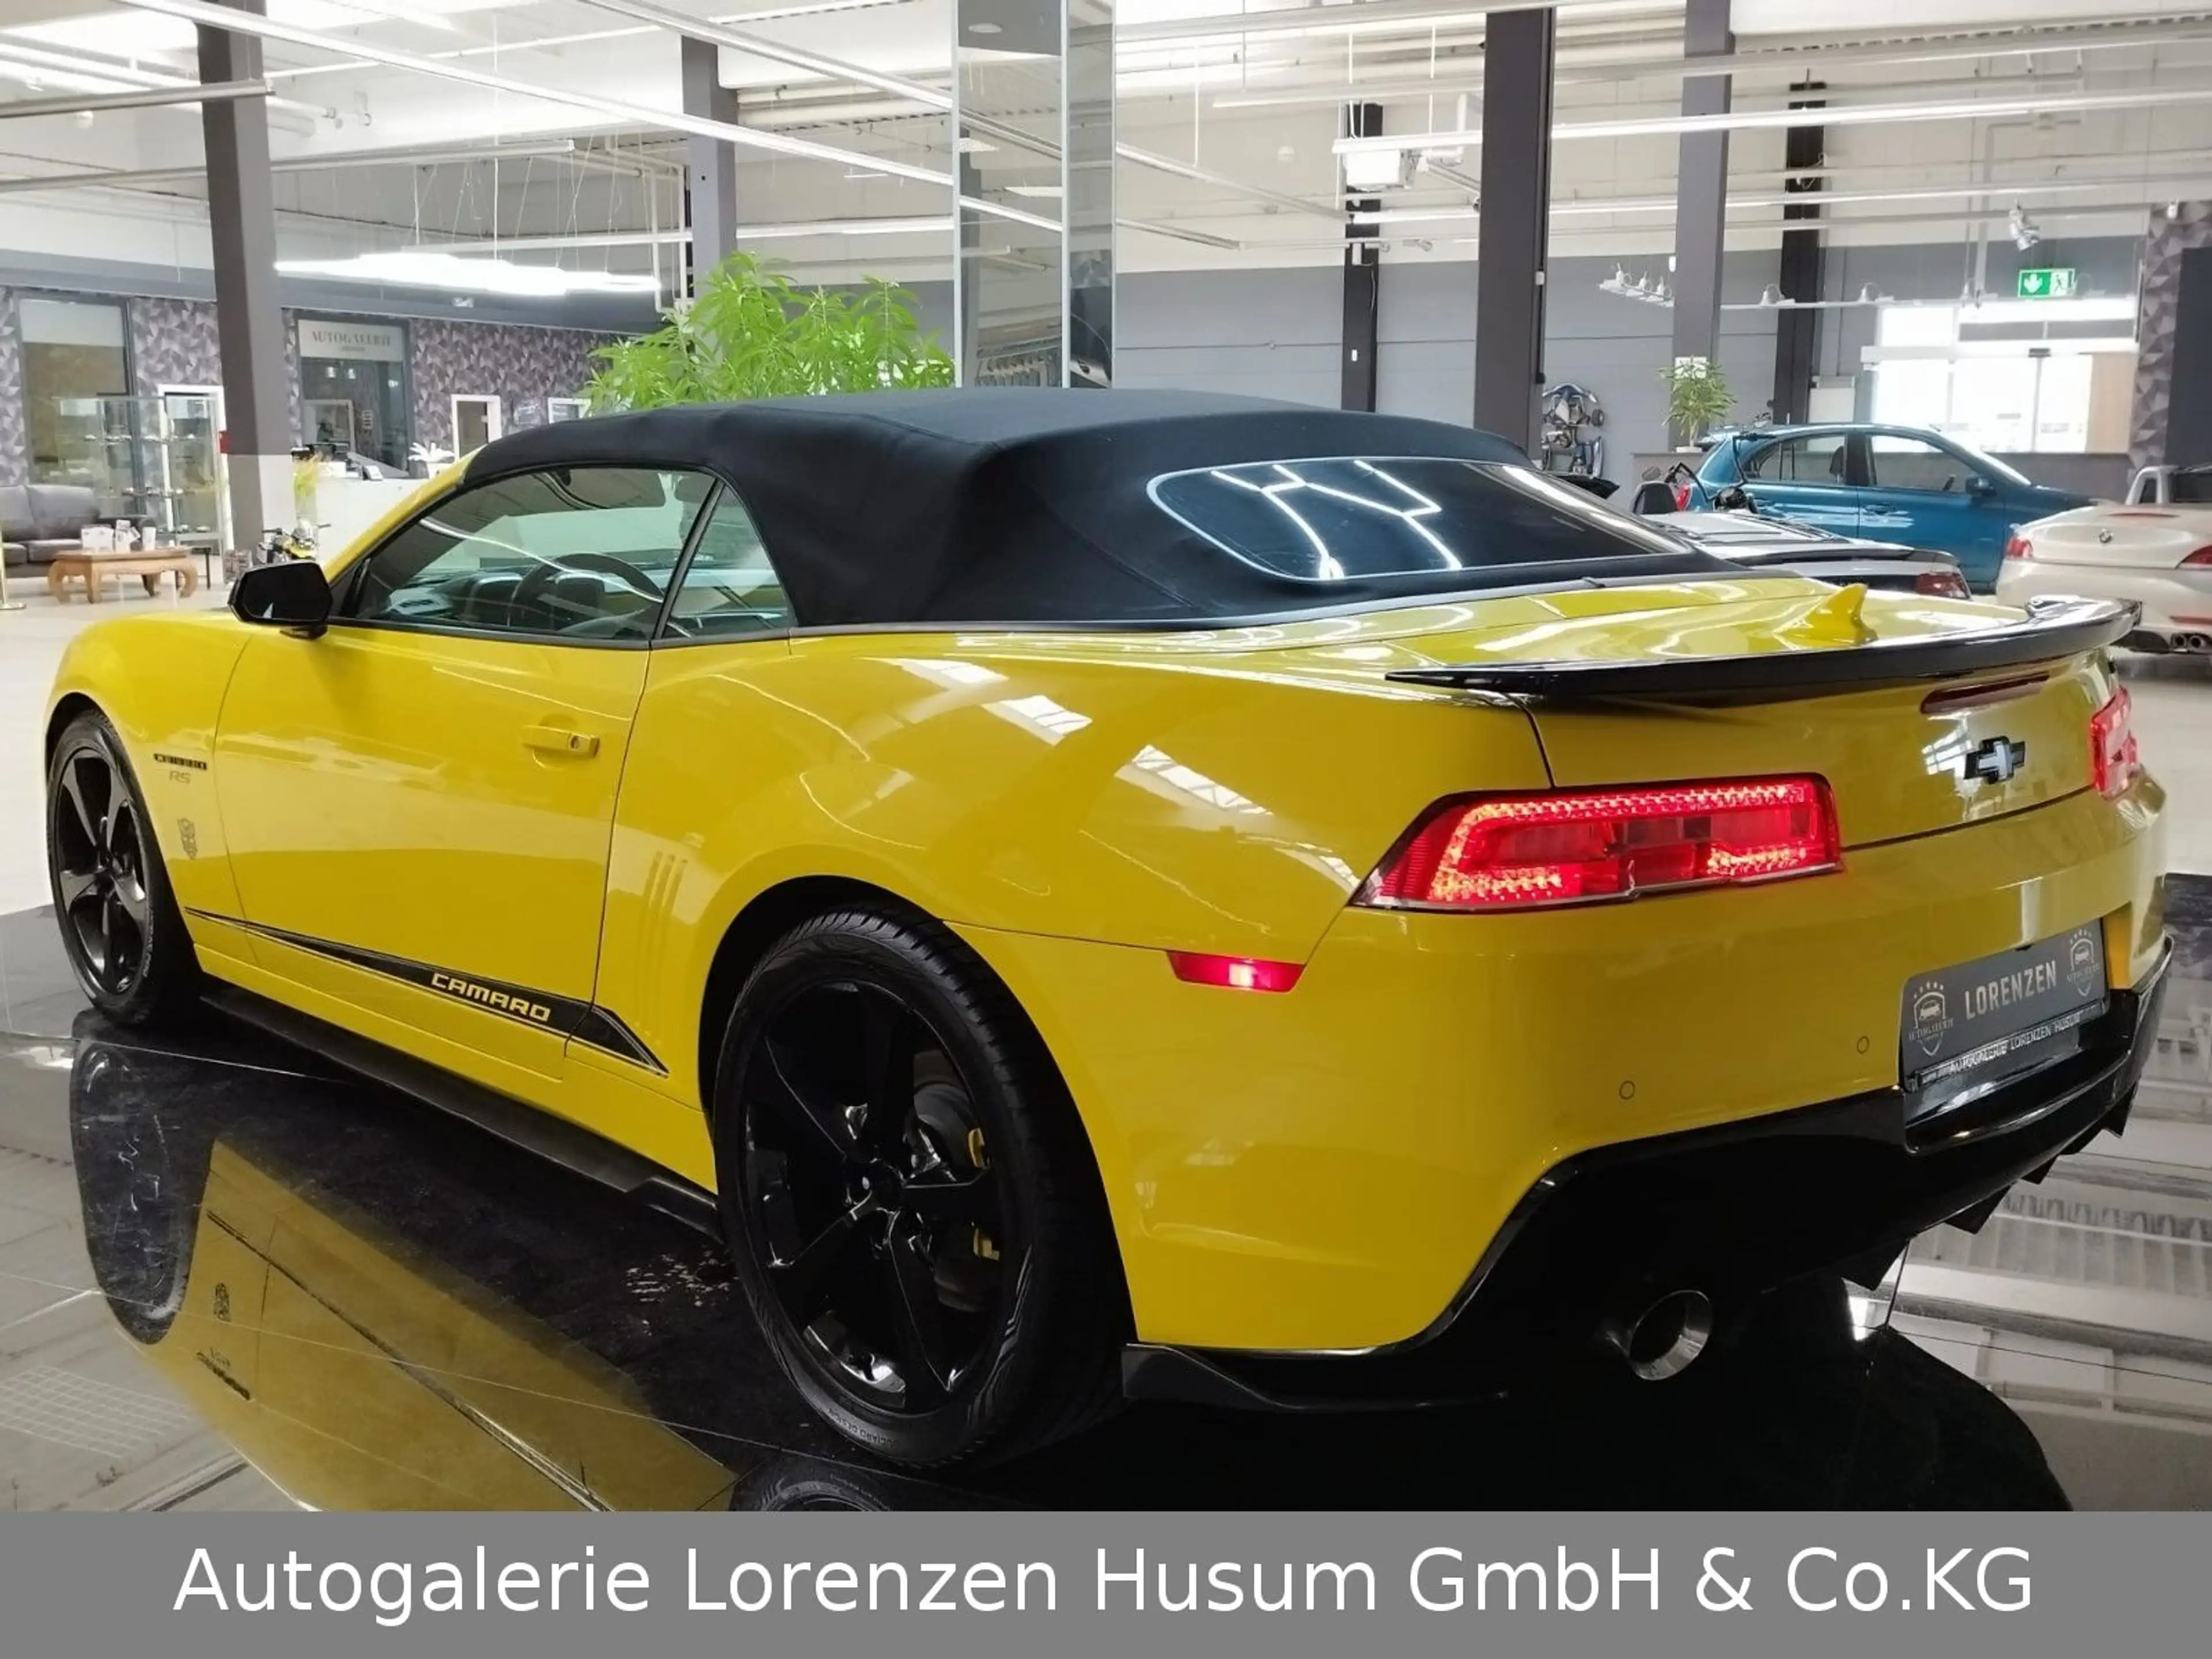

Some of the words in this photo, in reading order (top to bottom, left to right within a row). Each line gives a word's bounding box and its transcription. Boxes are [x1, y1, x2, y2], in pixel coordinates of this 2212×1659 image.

[169, 770, 191, 785] RS
[431, 972, 551, 1022] CAMARO
[1964, 959, 2057, 1021] LORENZEN
[2010, 1025, 2052, 1050] LORENZEN
